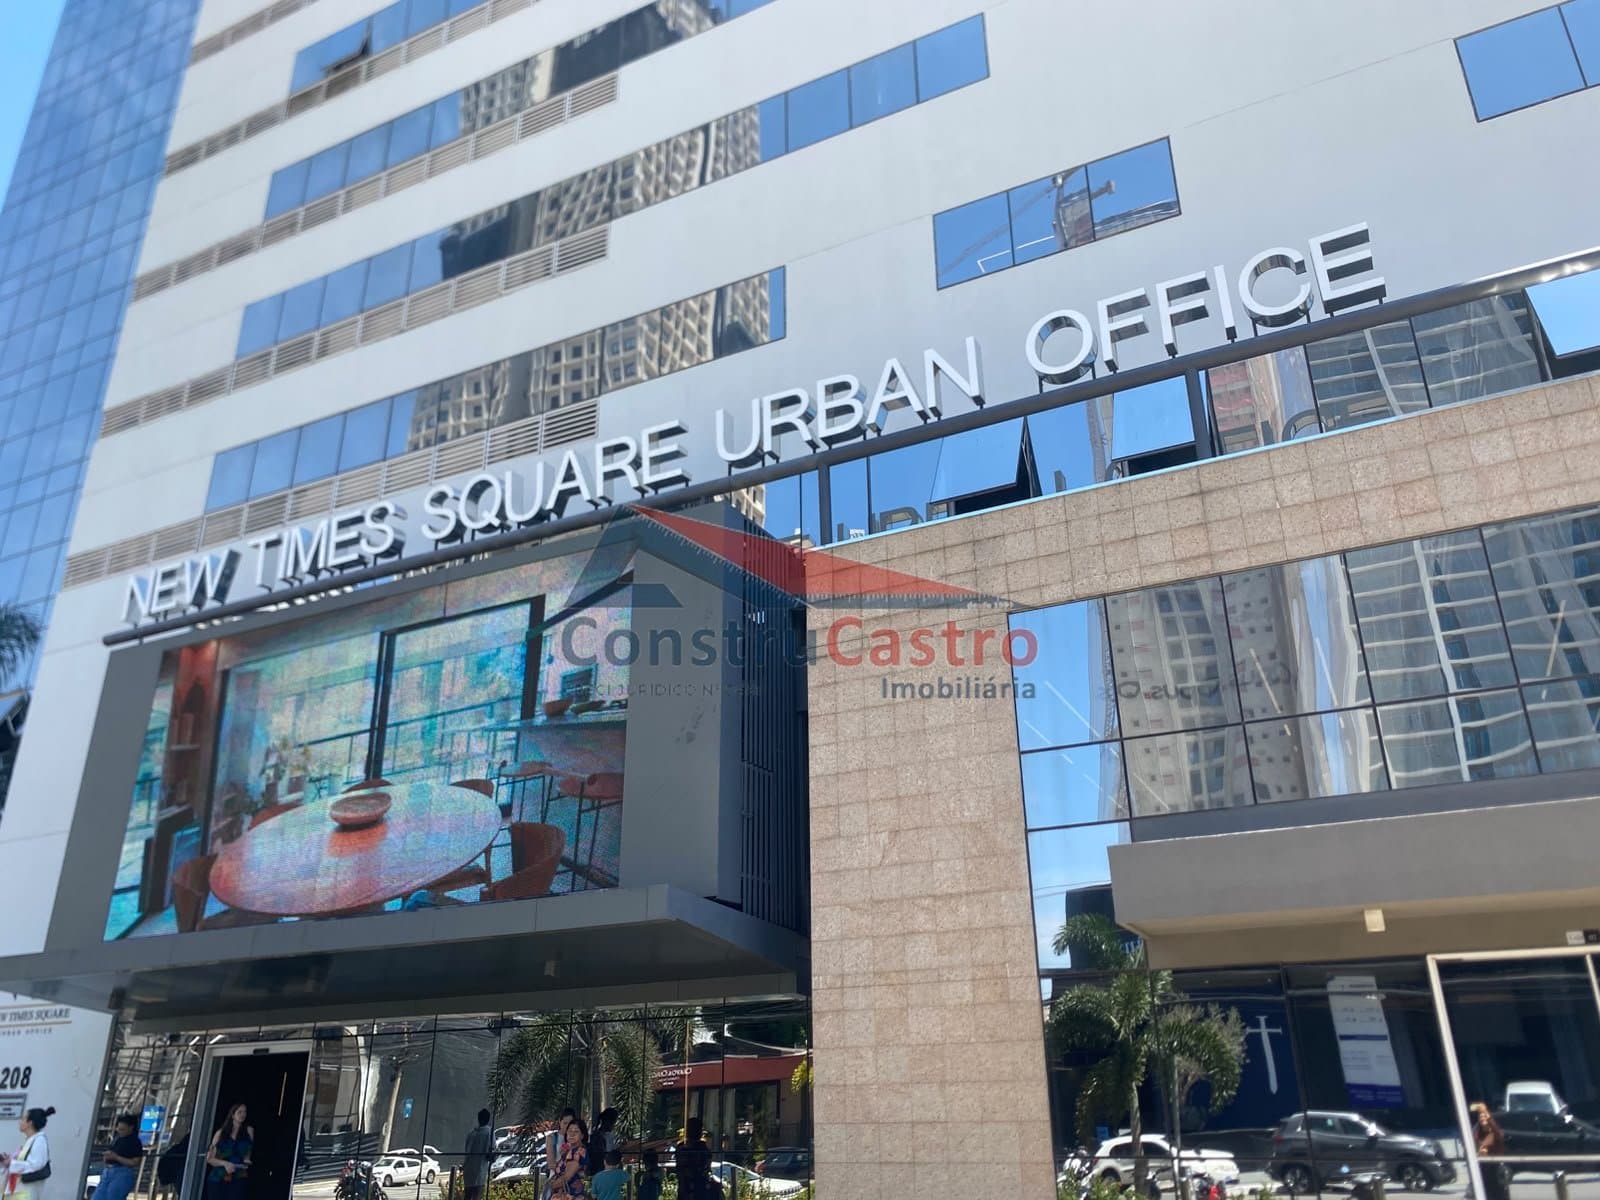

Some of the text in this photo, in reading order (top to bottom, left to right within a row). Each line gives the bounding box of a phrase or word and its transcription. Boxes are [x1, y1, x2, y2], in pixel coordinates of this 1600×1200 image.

[121, 222, 1387, 622] NEW TIMES SQUARE URBAN OFFICE
